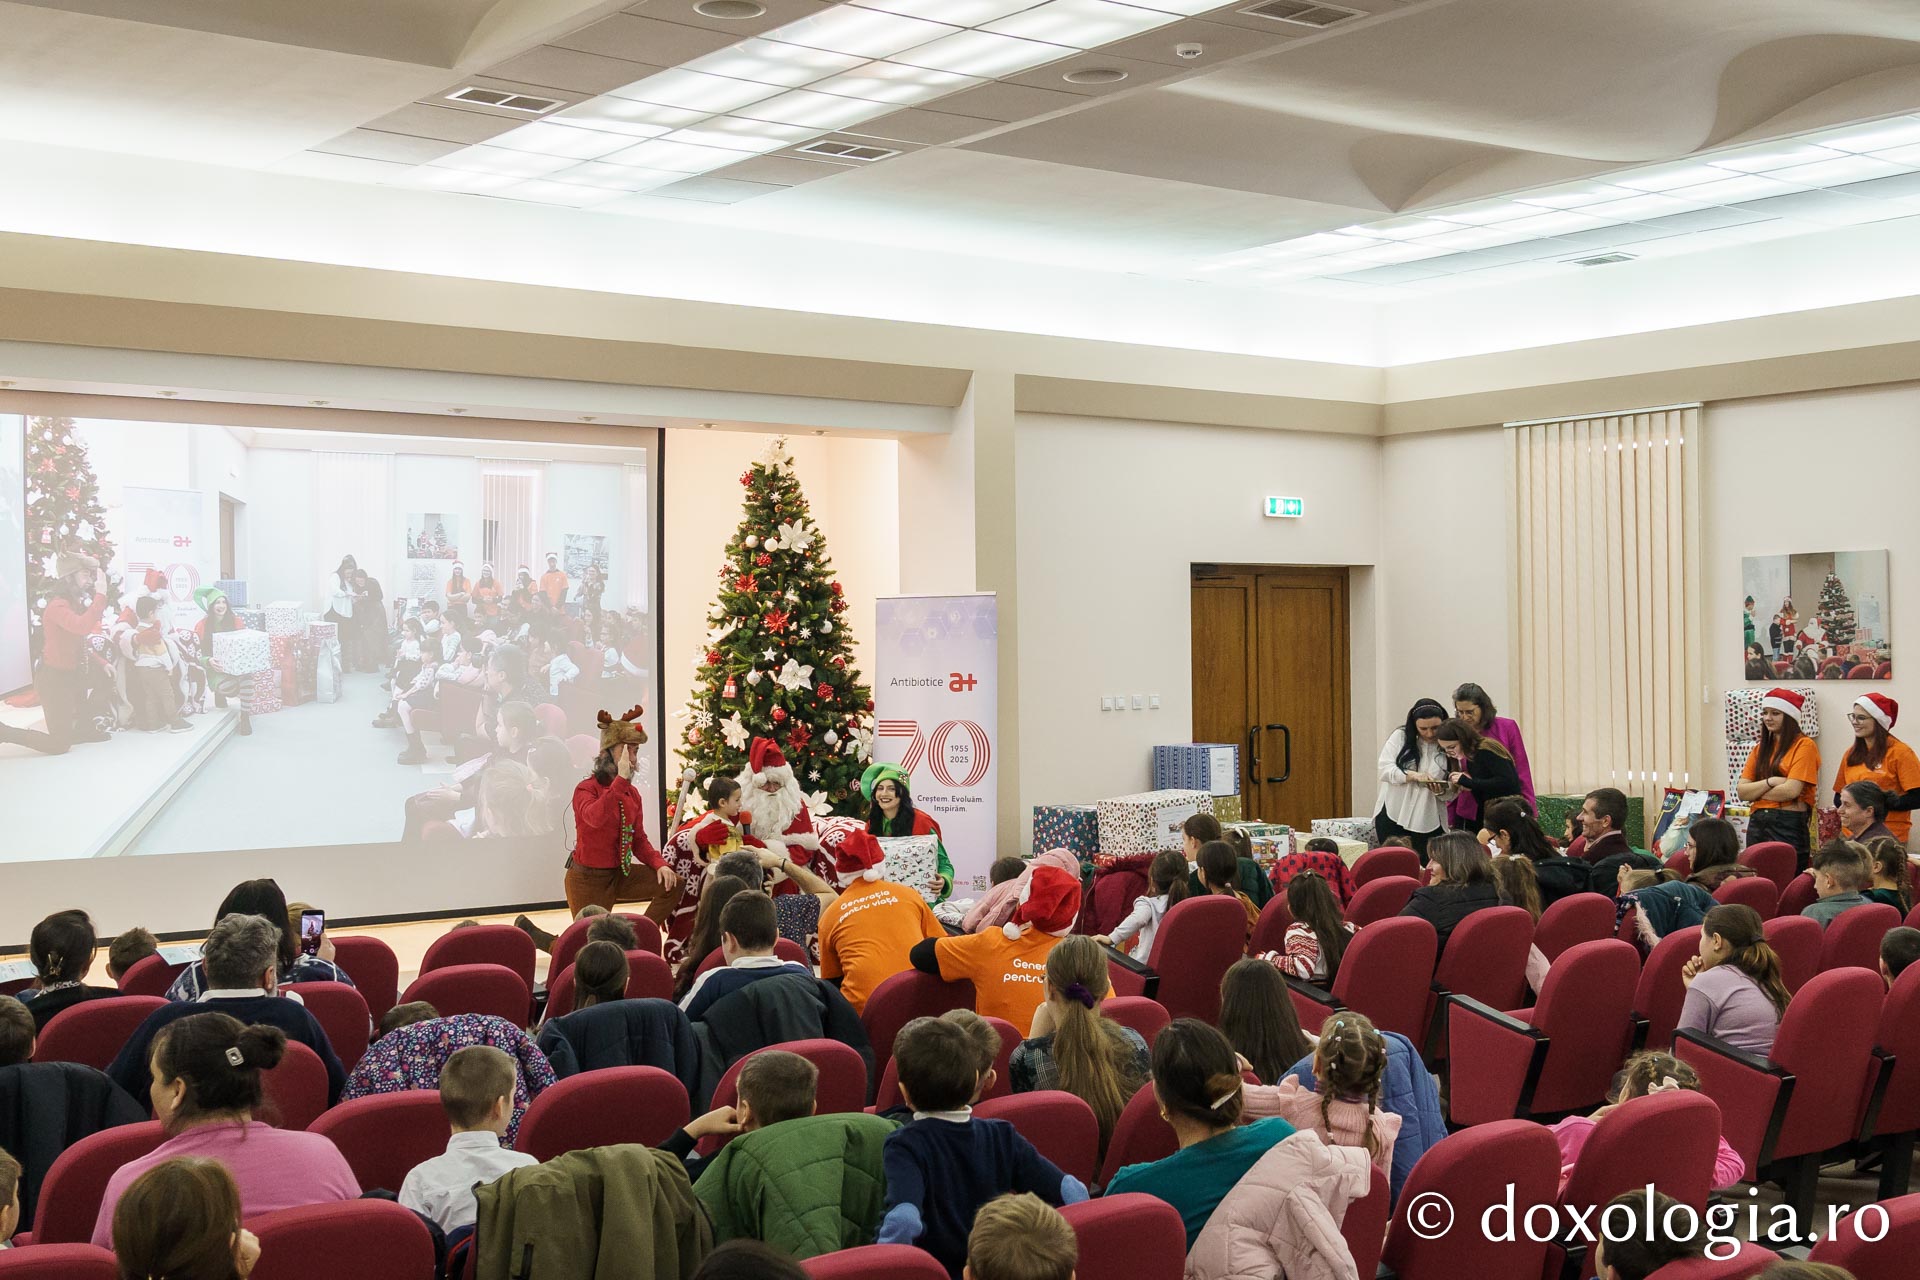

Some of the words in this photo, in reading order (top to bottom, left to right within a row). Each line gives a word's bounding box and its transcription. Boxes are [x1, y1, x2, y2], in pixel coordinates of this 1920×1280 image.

[890, 677, 944, 687] Antibiotice
[948, 672, 978, 692] a+
[949, 744, 969, 753] 1955
[949, 755, 969, 764] 2025
[839, 903, 870, 923] pentru
[1012, 958, 1047, 971] Gener
